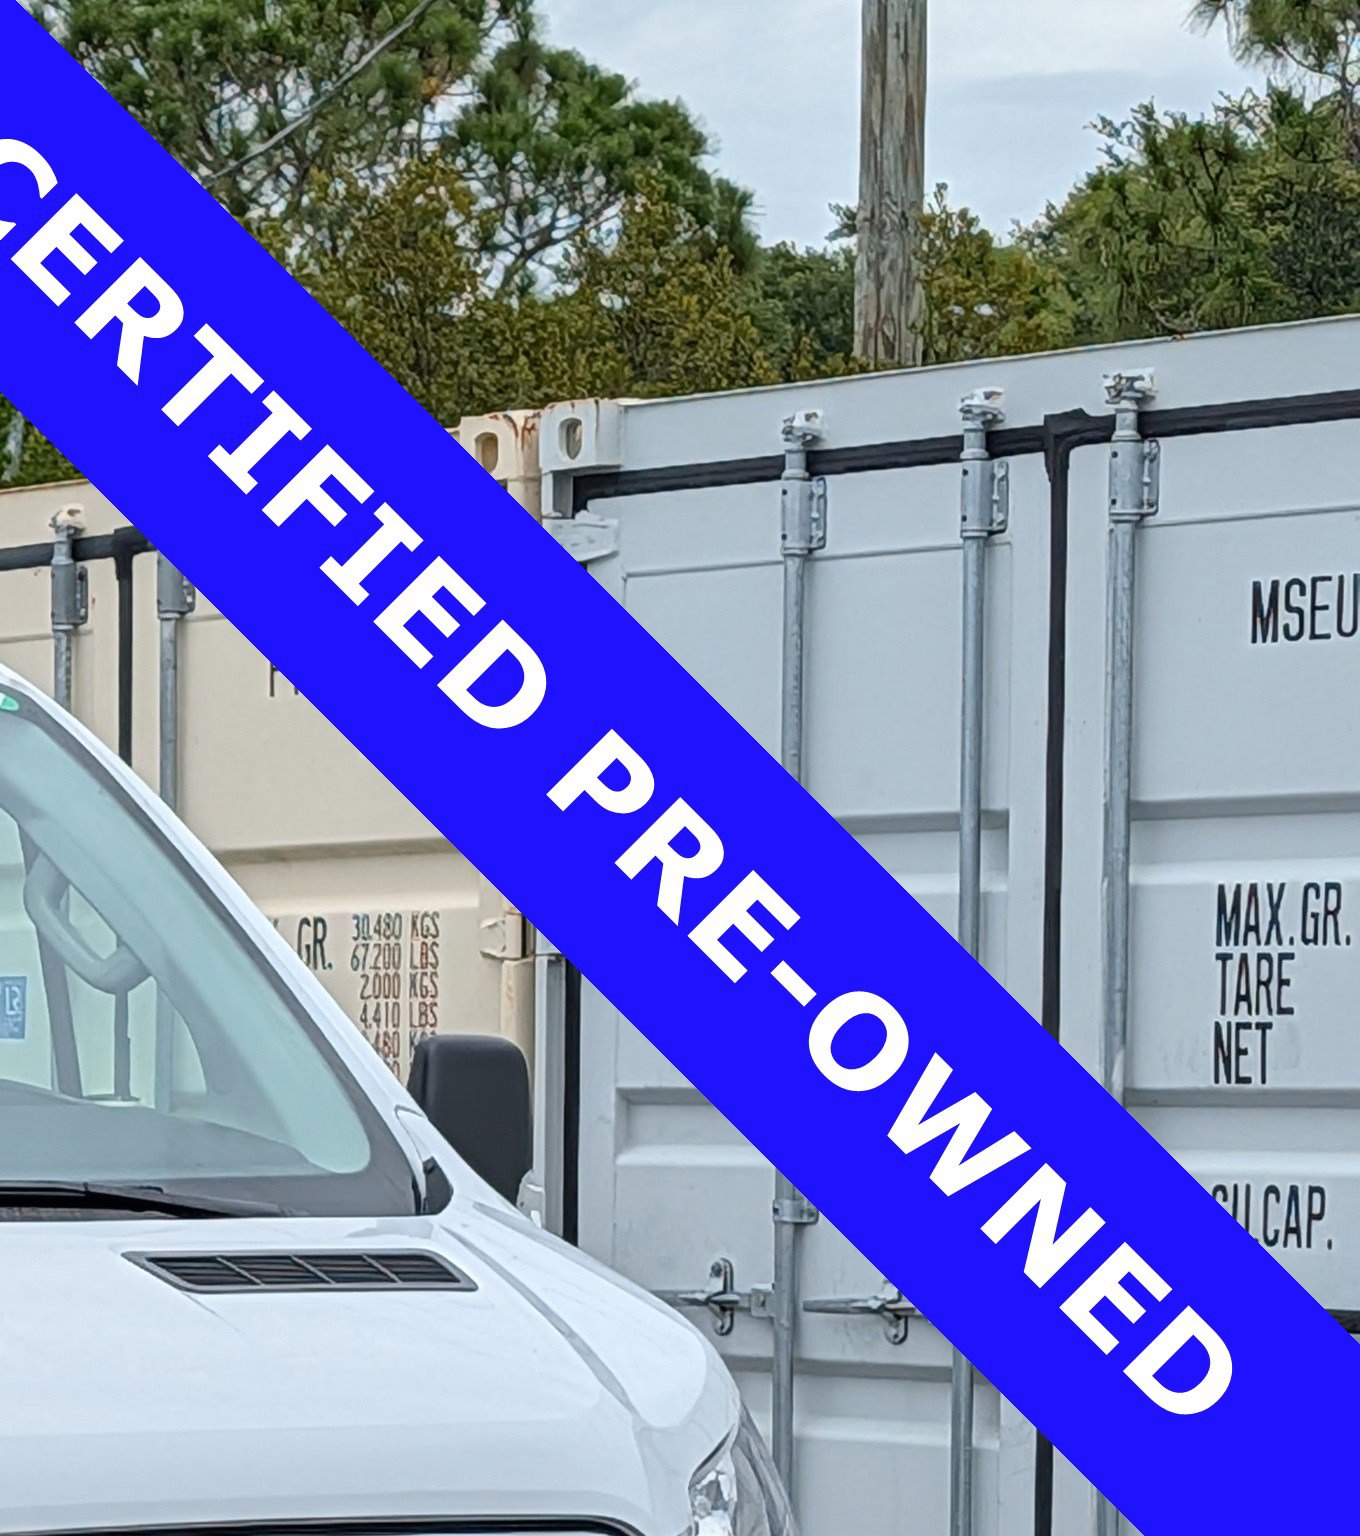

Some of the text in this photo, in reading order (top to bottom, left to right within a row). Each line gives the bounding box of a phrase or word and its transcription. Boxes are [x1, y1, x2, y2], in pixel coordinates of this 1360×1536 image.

[1251, 573, 1360, 644] MSEU
[410, 912, 440, 939] KGS
[409, 941, 440, 970] LBS
[409, 972, 439, 999] KGS
[1215, 952, 1295, 1016] TARE
[409, 1002, 438, 1029] LBS
[1214, 1021, 1273, 1085] NET
